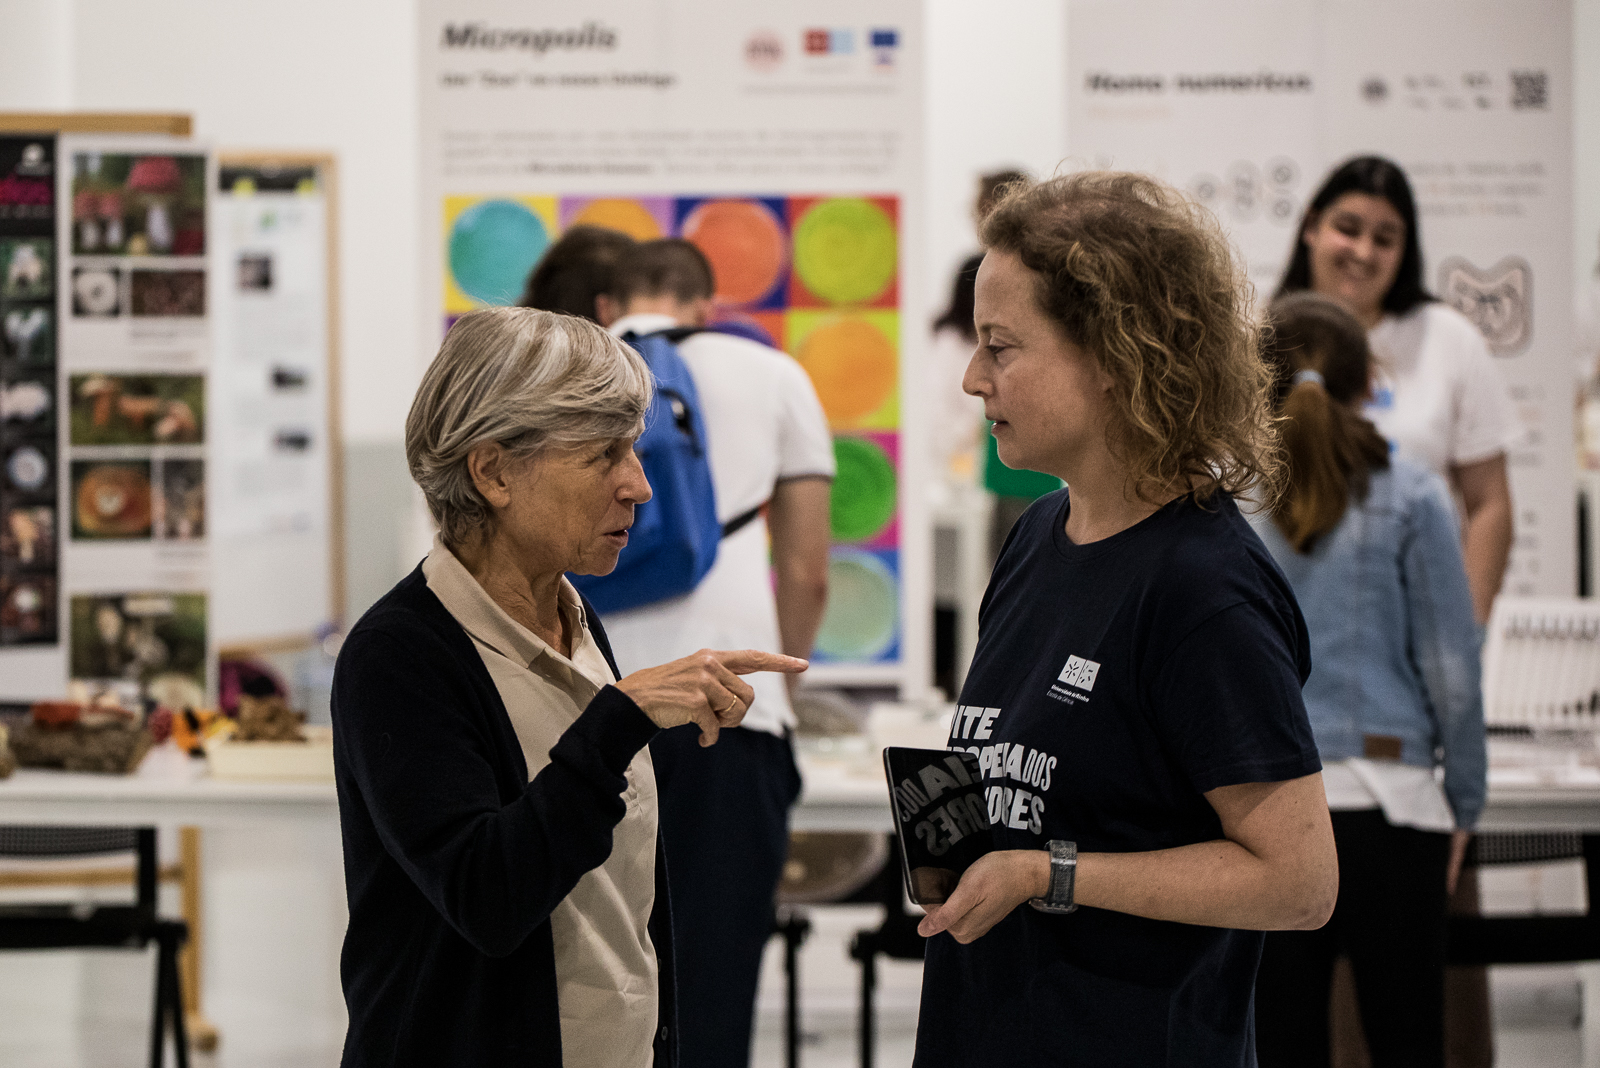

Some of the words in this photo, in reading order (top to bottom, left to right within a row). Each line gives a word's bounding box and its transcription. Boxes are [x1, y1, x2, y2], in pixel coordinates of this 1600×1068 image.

[440, 20, 619, 56] Micropolis
[1085, 71, 1167, 93] Homo
[1174, 69, 1312, 93] numericus
[1022, 748, 1058, 792] DOS
